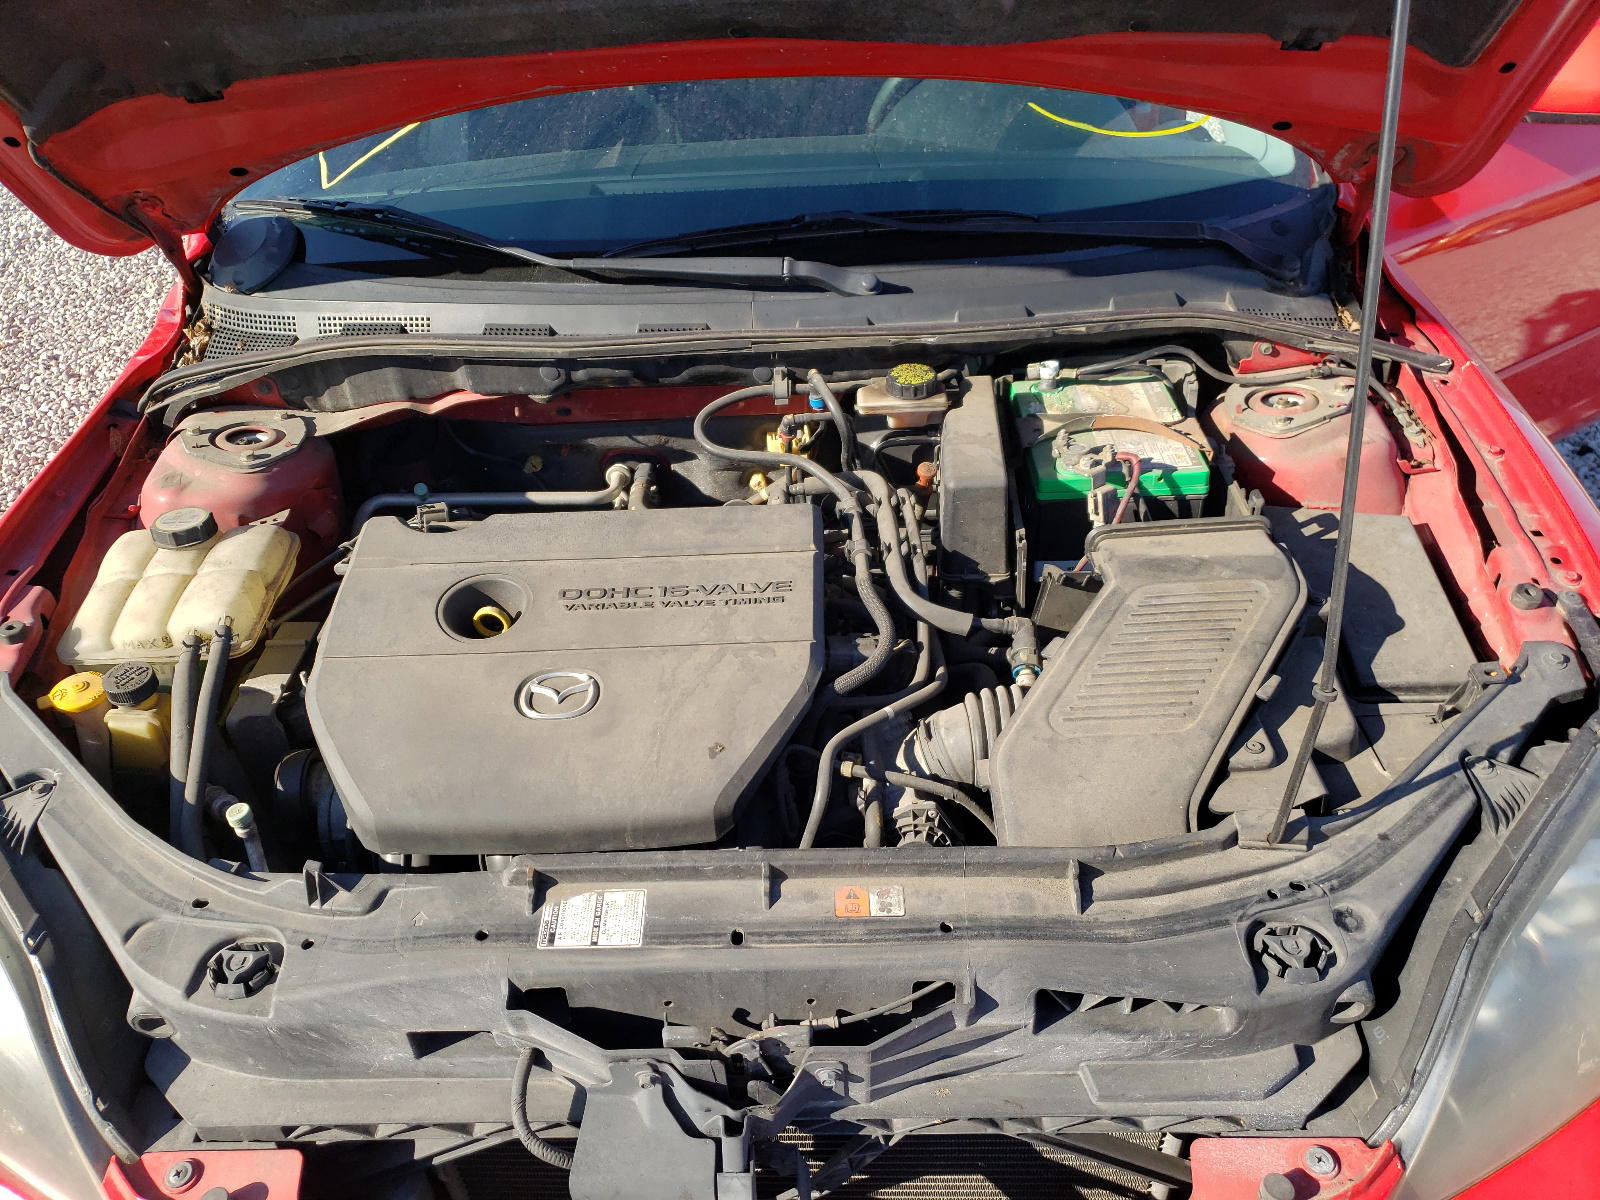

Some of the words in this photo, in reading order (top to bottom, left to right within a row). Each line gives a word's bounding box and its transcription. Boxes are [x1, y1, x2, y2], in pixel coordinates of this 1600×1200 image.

[558, 586, 653, 601] DOHC
[658, 580, 793, 598] 16-VALVE
[564, 600, 655, 611] VARIABLE
[661, 598, 717, 609] VALVE
[720, 595, 786, 607] TIMING
[550, 905, 559, 933] CAUTION
